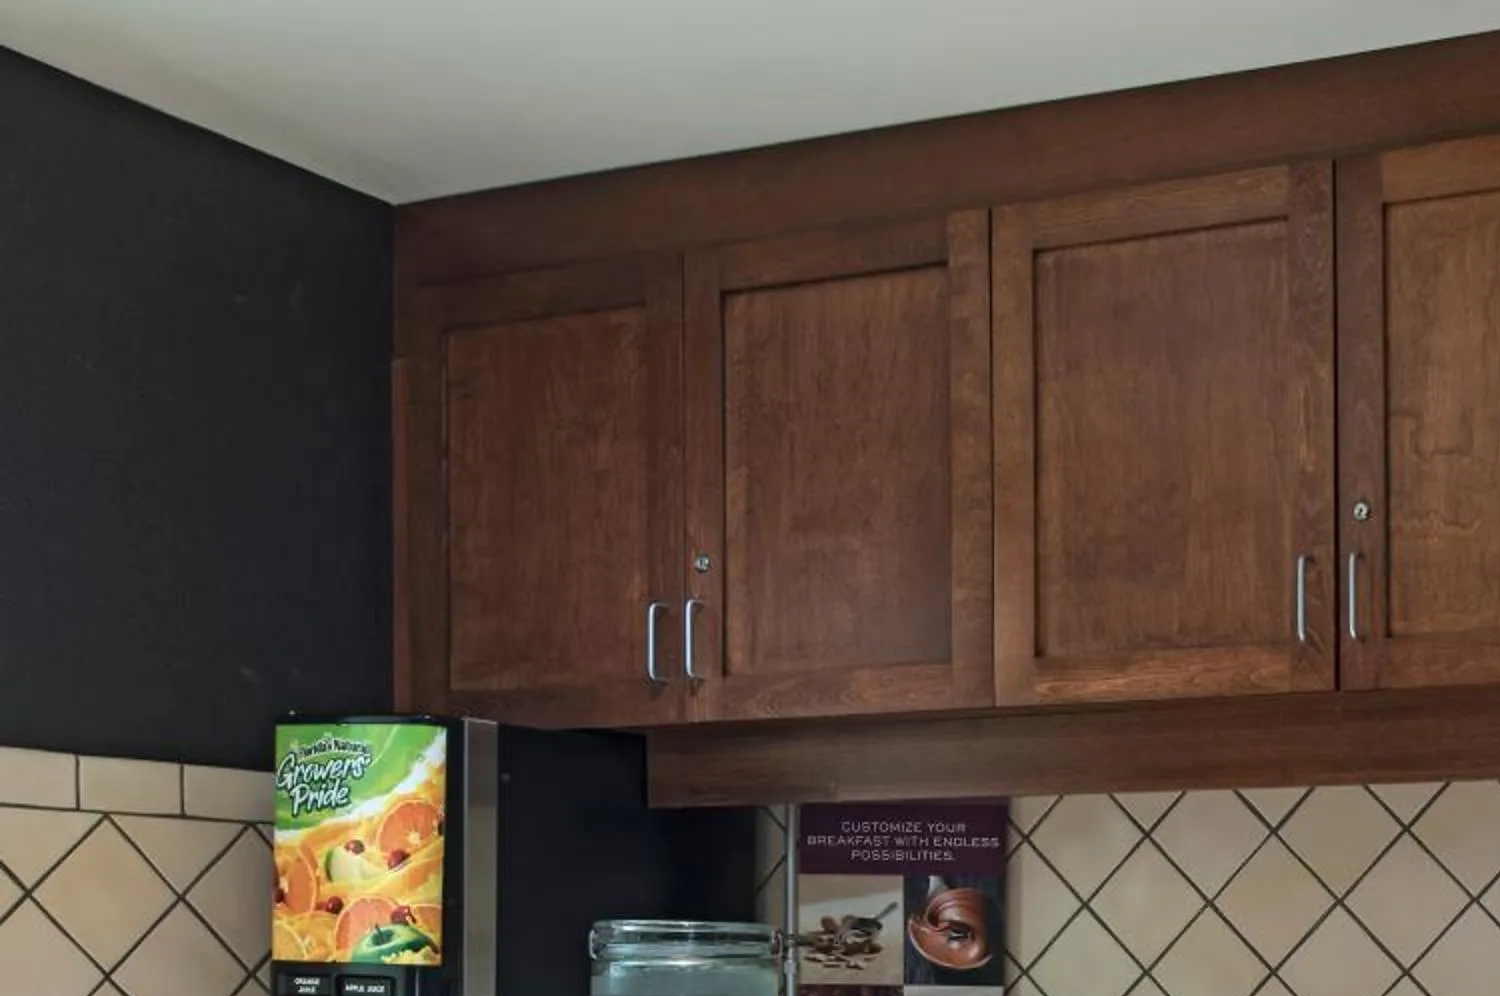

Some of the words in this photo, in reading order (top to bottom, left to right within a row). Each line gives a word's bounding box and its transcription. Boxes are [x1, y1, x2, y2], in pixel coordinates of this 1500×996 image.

[290, 778, 350, 816] Pride
[841, 821, 923, 834] CUSTOMIZE
[927, 822, 967, 834] YOUR
[807, 834, 891, 848] BREAKFAST
[894, 835, 930, 848] WITH
[933, 836, 1000, 849] ENDLESS
